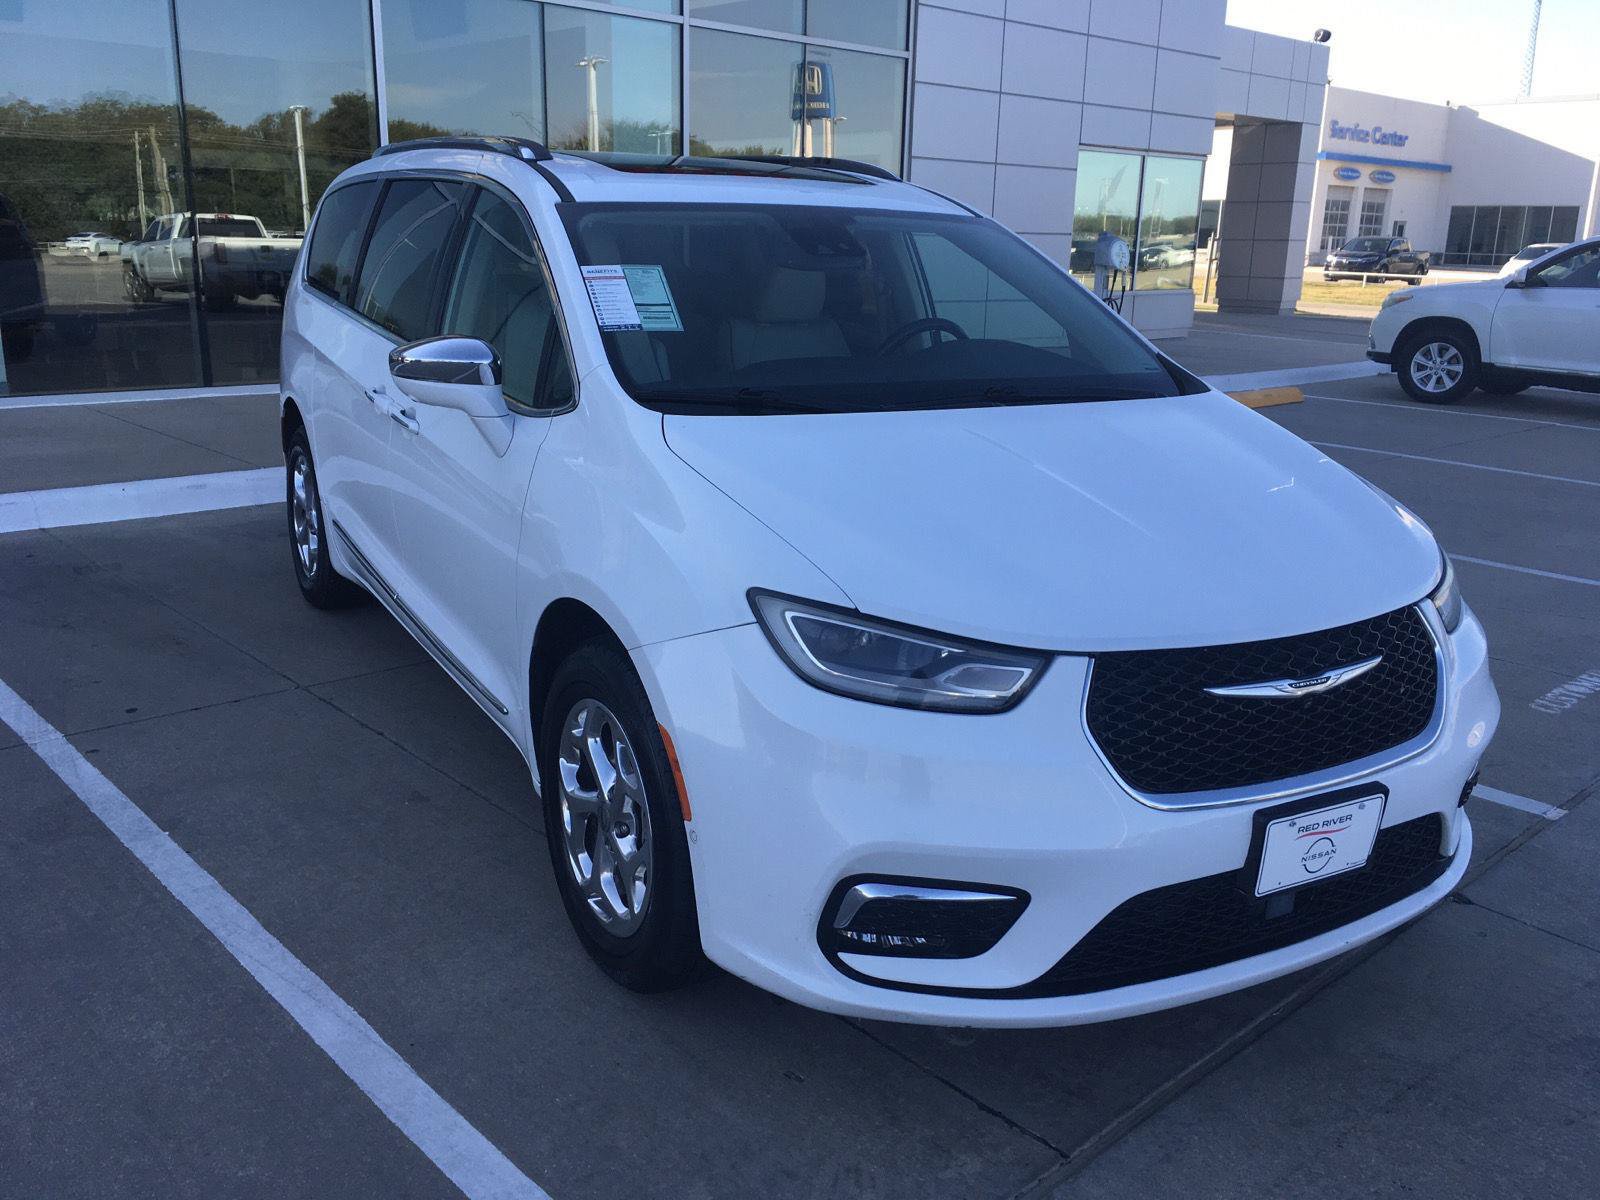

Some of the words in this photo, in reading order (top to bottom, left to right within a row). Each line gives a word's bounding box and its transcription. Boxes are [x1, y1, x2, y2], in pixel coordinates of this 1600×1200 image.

[1330, 120, 1370, 143] Service
[1371, 126, 1408, 147] Center
[1297, 823, 1320, 834] RED
[1321, 814, 1353, 828] RIVER
[1301, 848, 1337, 863] NISSAN
